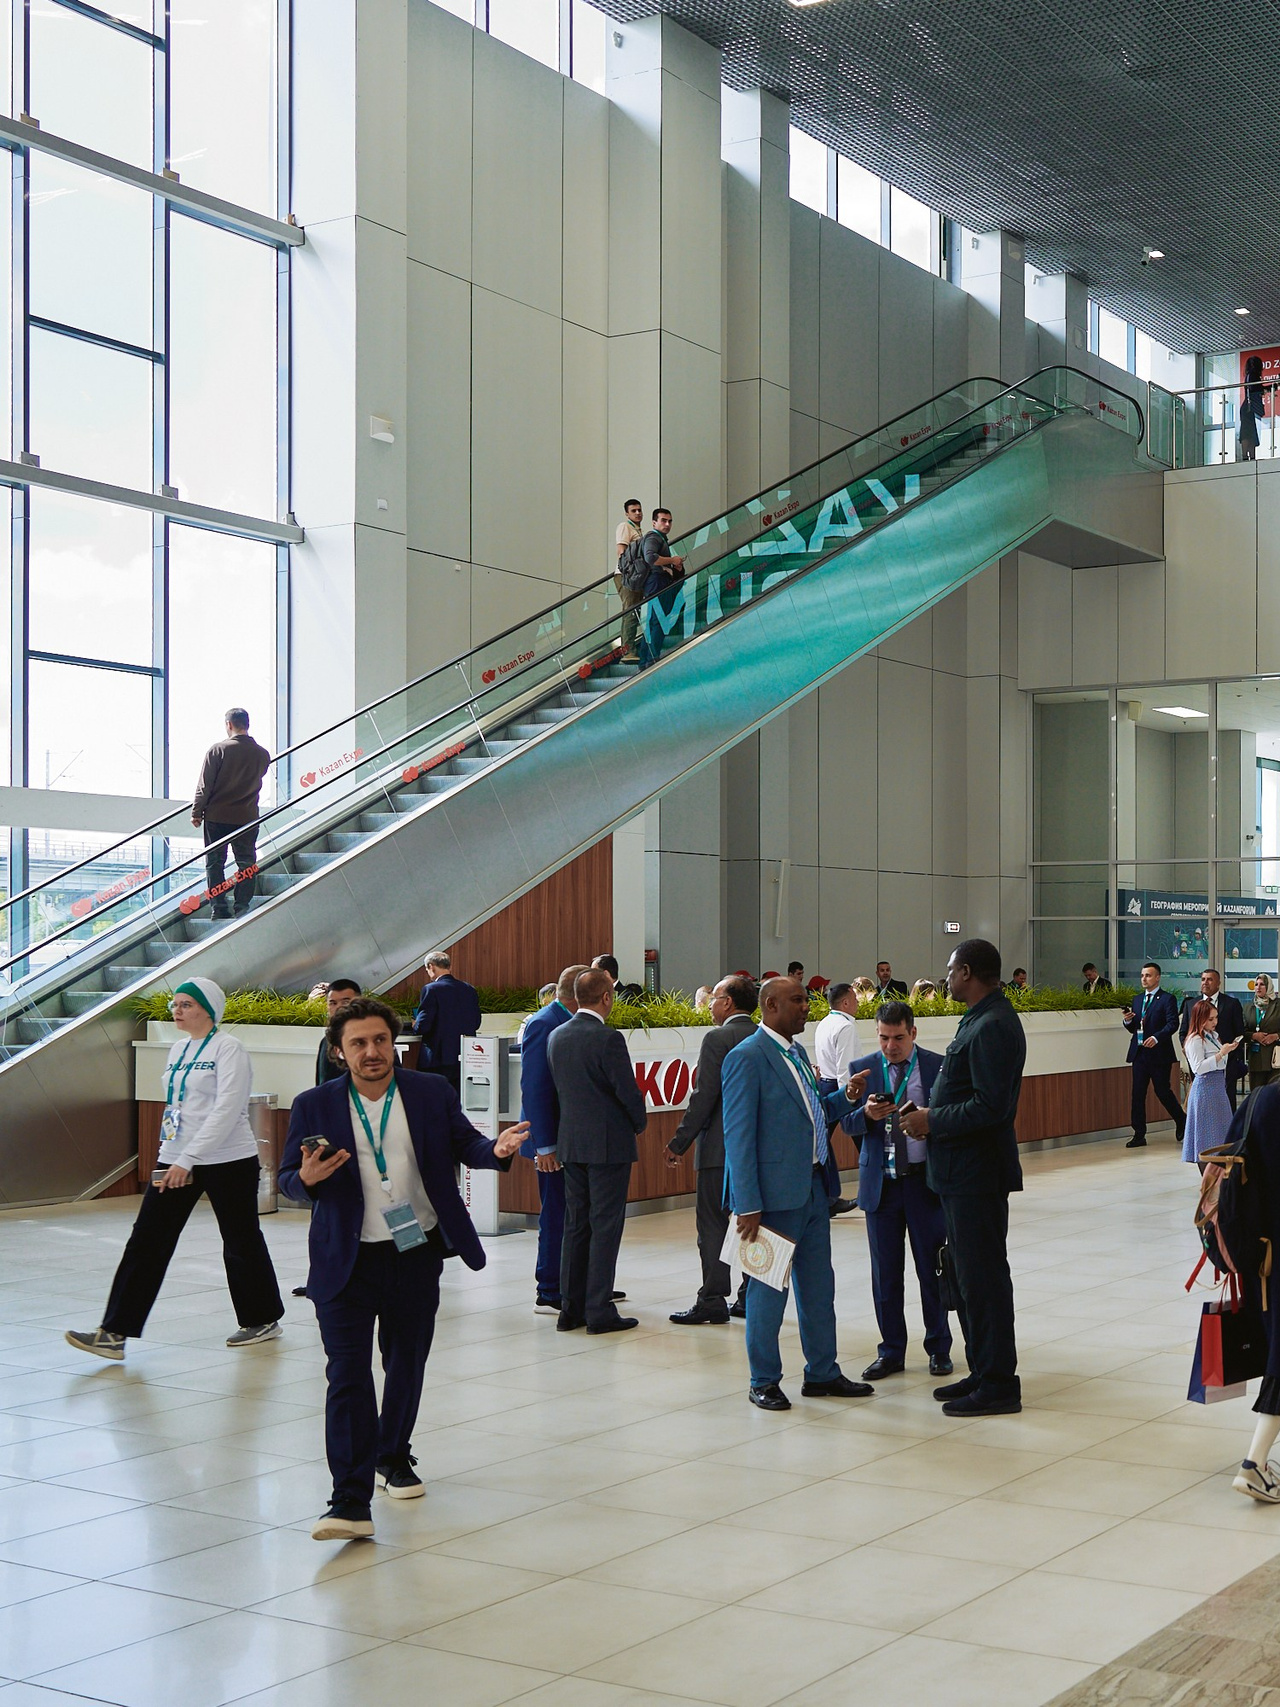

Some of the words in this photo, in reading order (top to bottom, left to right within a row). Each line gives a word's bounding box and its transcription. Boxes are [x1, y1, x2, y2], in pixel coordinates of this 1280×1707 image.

[773, 505, 788, 520] Kazan
[786, 500, 800, 513] Expo
[497, 658, 518, 675] Kazan
[518, 648, 535, 664] Expo
[318, 756, 344, 777] Kazan
[345, 747, 364, 764] Expo
[421, 752, 447, 772] Kazan
[445, 741, 466, 759] Expo
[95, 883, 126, 904] Kazan
[126, 867, 150, 888] Expo
[204, 878, 236, 902] Kazan
[234, 864, 260, 884] Expo
[1150, 900, 1182, 910] ГЕОГРАФИЯ
[1183, 902, 1222, 913] МЕРОПРИЙ
[1223, 904, 1257, 916] KAZANFORUM
